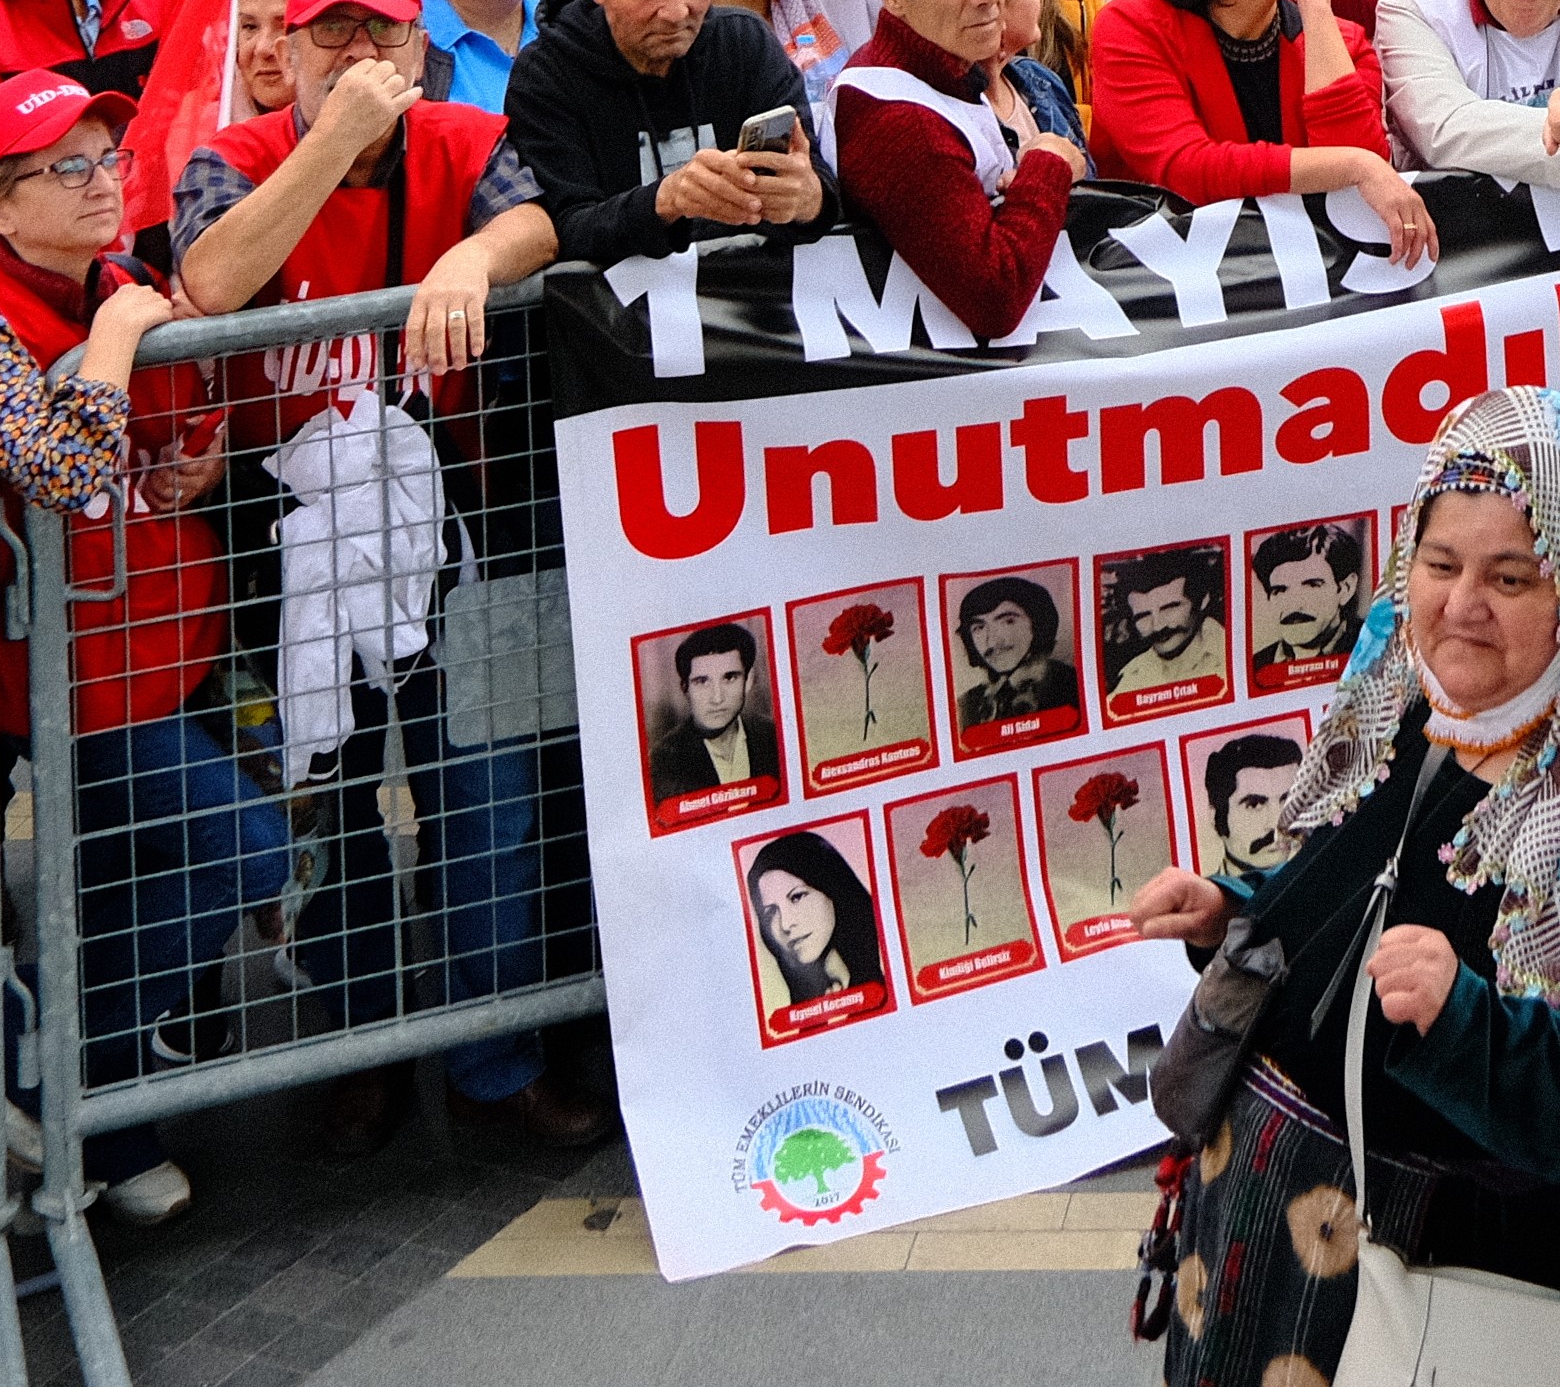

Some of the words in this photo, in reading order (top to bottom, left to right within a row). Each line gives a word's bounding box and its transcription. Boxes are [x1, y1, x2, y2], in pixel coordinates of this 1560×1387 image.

[603, 243, 705, 379] 1
[741, 1079, 829, 1153] EMEKLİLERİN
[834, 1085, 902, 1155] SENDİKASI
